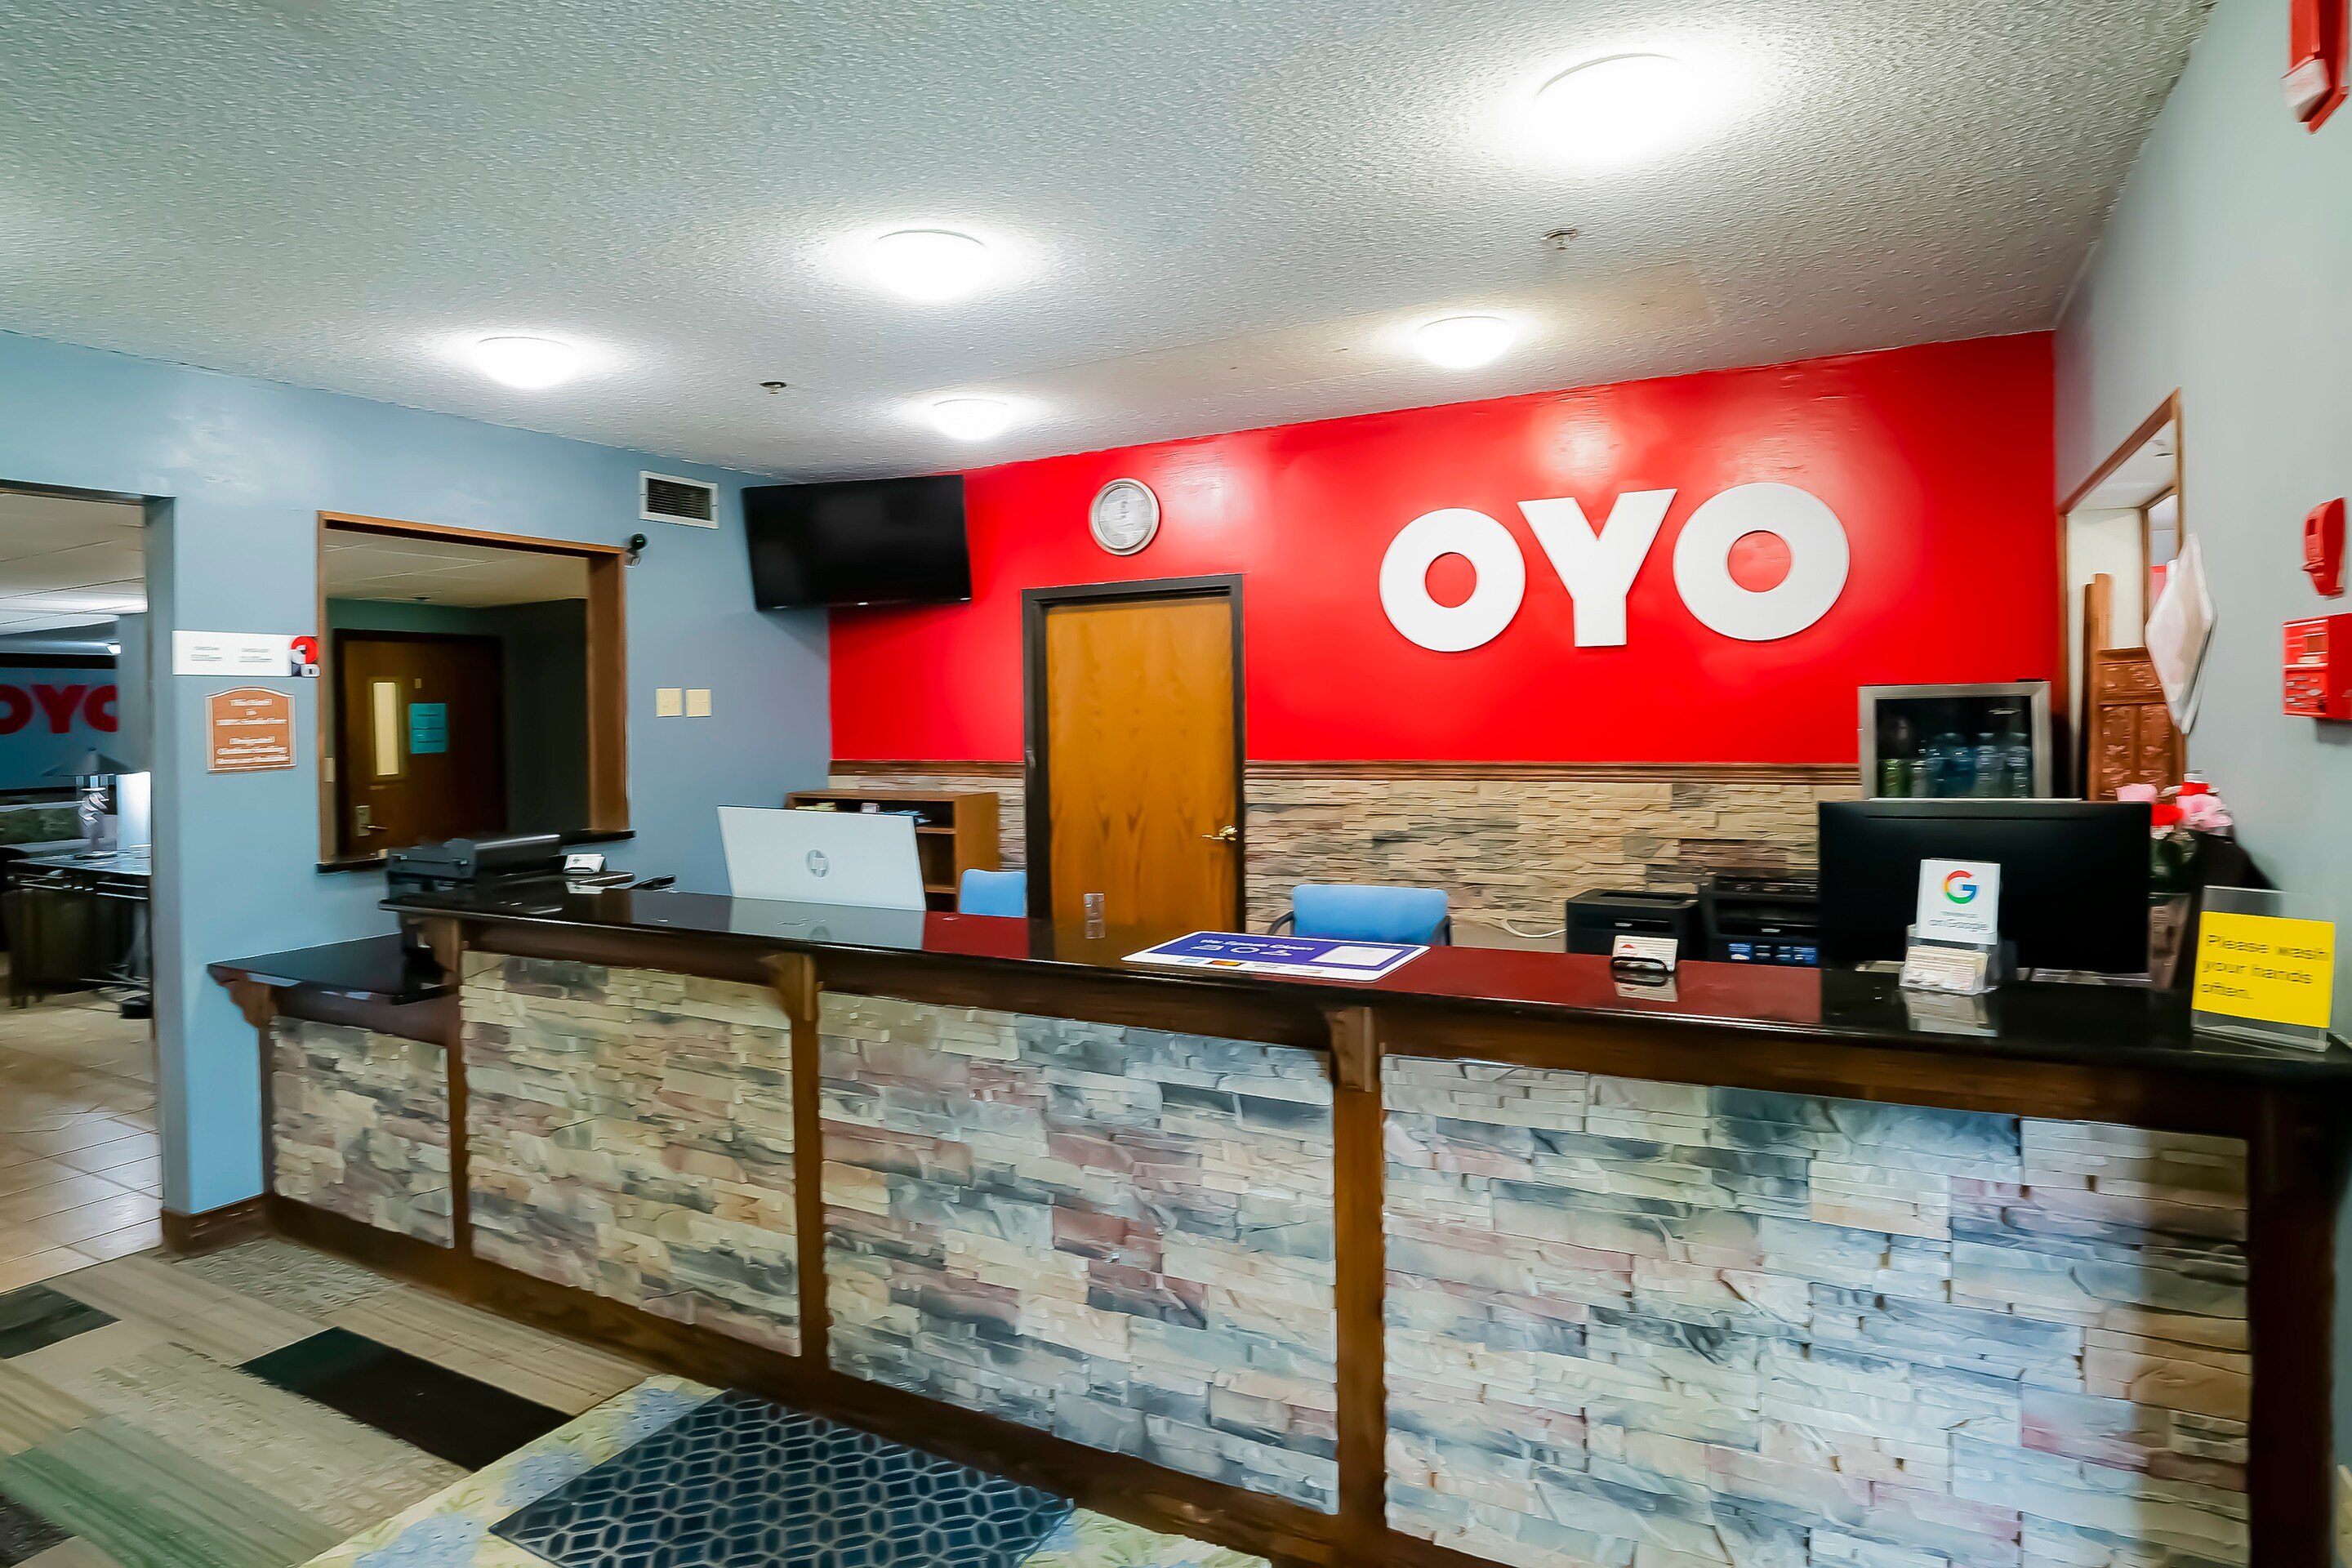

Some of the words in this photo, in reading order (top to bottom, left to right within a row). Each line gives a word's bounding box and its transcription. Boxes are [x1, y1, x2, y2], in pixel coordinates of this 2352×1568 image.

[1379, 482, 1851, 652] OYO
[1945, 919, 1989, 932] Google
[2207, 934, 2270, 954] Please
[2276, 947, 2329, 961] wash
[2203, 960, 2247, 973] your
[2252, 964, 2314, 984] hands
